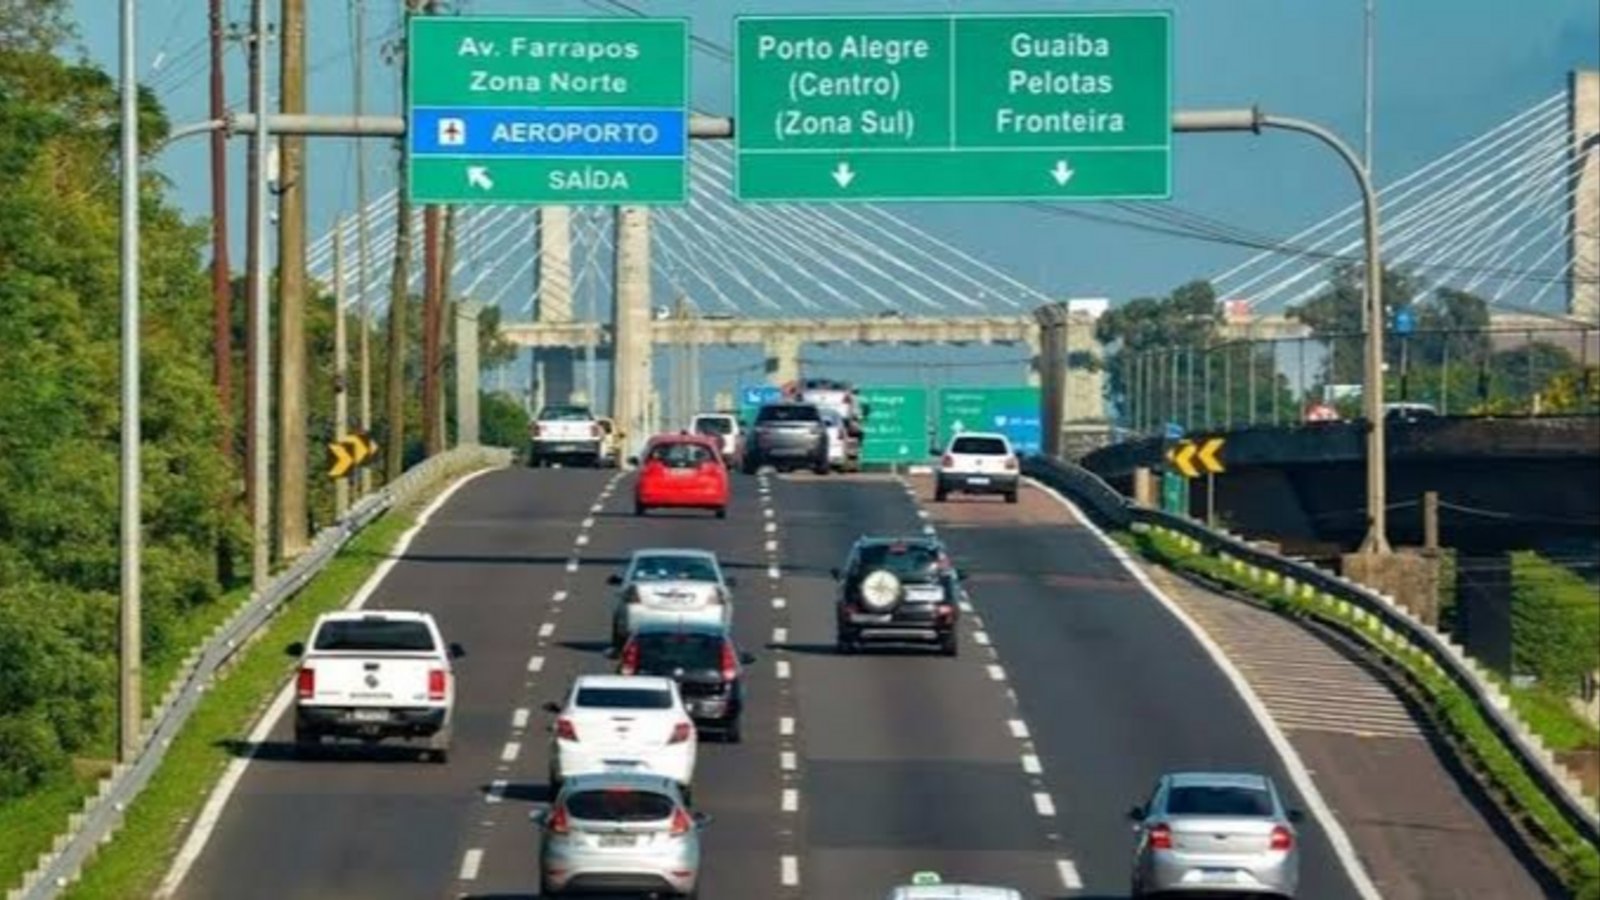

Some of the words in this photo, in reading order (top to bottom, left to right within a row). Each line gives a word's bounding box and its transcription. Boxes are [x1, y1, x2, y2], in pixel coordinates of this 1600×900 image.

[459, 37, 500, 57] Av.
[511, 37, 640, 61] Farrapos
[758, 35, 833, 60] Porto
[840, 35, 929, 65] Alegre
[470, 71, 541, 92] Zona
[550, 72, 628, 93] Norte
[789, 71, 900, 101] (Centro)
[1008, 69, 1113, 94] Pelotas
[775, 110, 852, 140] (Zona
[860, 110, 915, 140] Sul)
[996, 107, 1125, 133] Fronteira
[492, 122, 659, 144] AEROPORTO
[549, 166, 629, 190] SAÍDA
